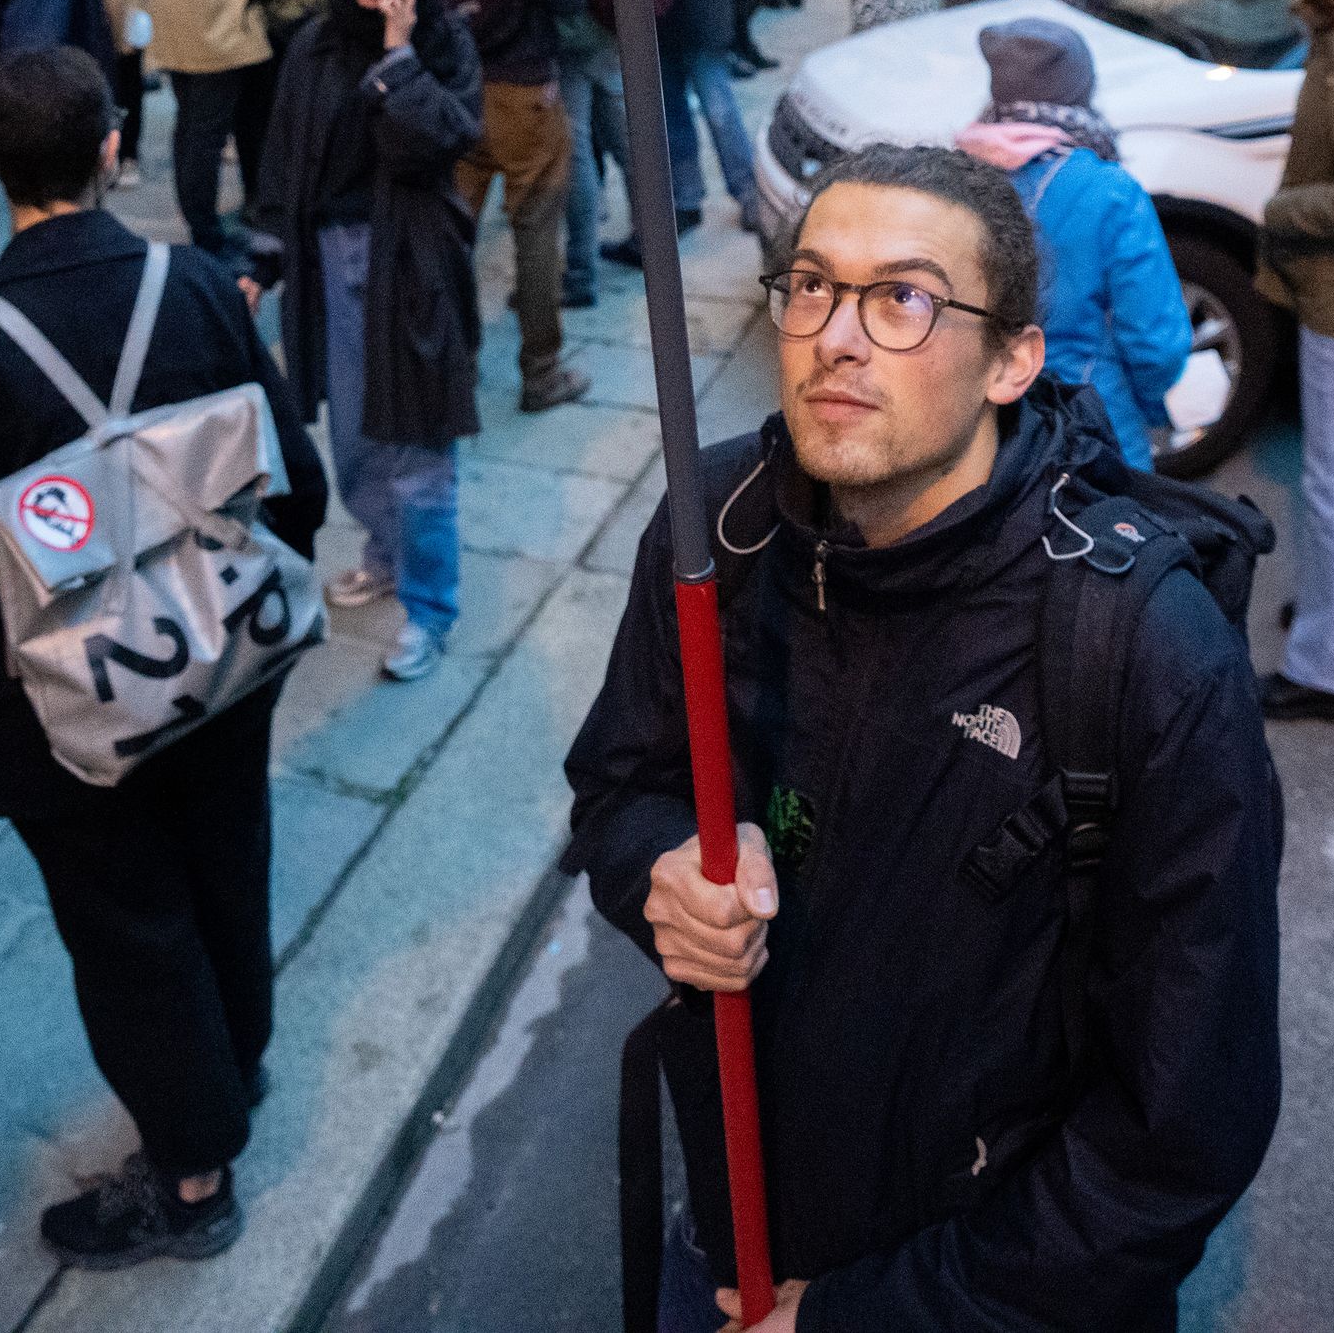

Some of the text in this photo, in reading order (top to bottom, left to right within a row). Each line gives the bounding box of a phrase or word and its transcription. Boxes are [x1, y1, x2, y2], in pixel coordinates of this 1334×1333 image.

[952, 711, 997, 736] NORTH
[979, 703, 1007, 726] THE
[963, 725, 1000, 748] FACE
